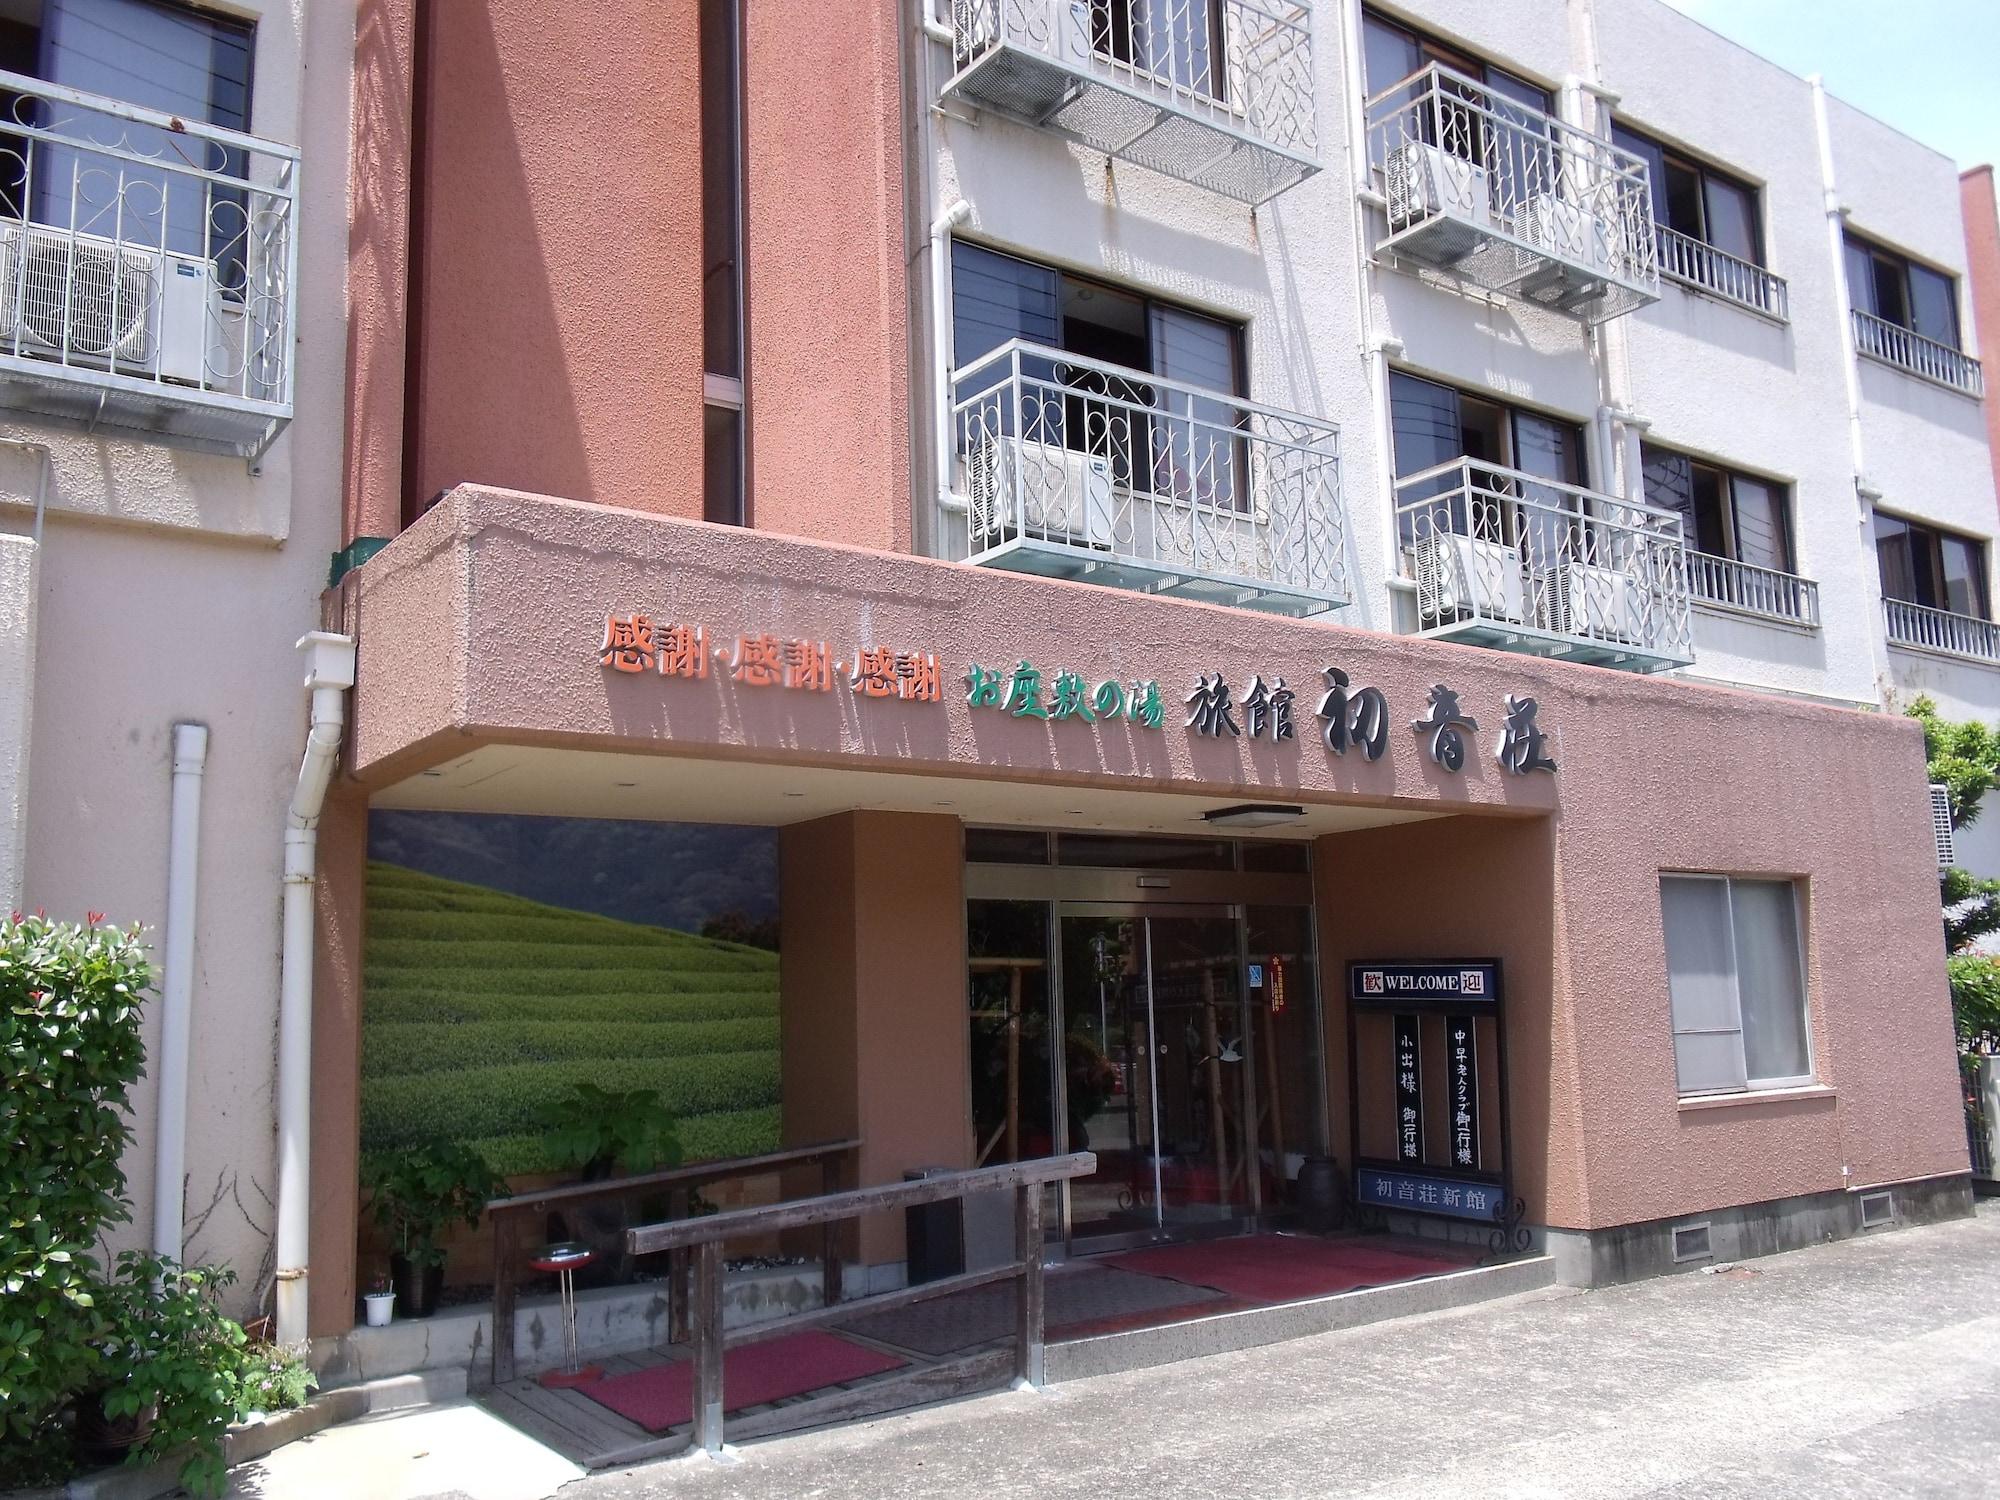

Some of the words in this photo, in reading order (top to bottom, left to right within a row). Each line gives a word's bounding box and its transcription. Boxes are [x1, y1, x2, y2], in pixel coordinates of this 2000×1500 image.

[966, 660, 1165, 729] お座敷の湯
[1185, 671, 1296, 744] 旅館
[1316, 666, 1558, 776] 初音荘
[1364, 973, 1383, 992] 歓
[1385, 975, 1459, 991] WELCOME
[1462, 973, 1482, 993] 迎
[1401, 1034, 1417, 1094] 小出様
[1402, 1106, 1417, 1158] 御一行様
[1375, 1178, 1487, 1211] 初音荘新館
